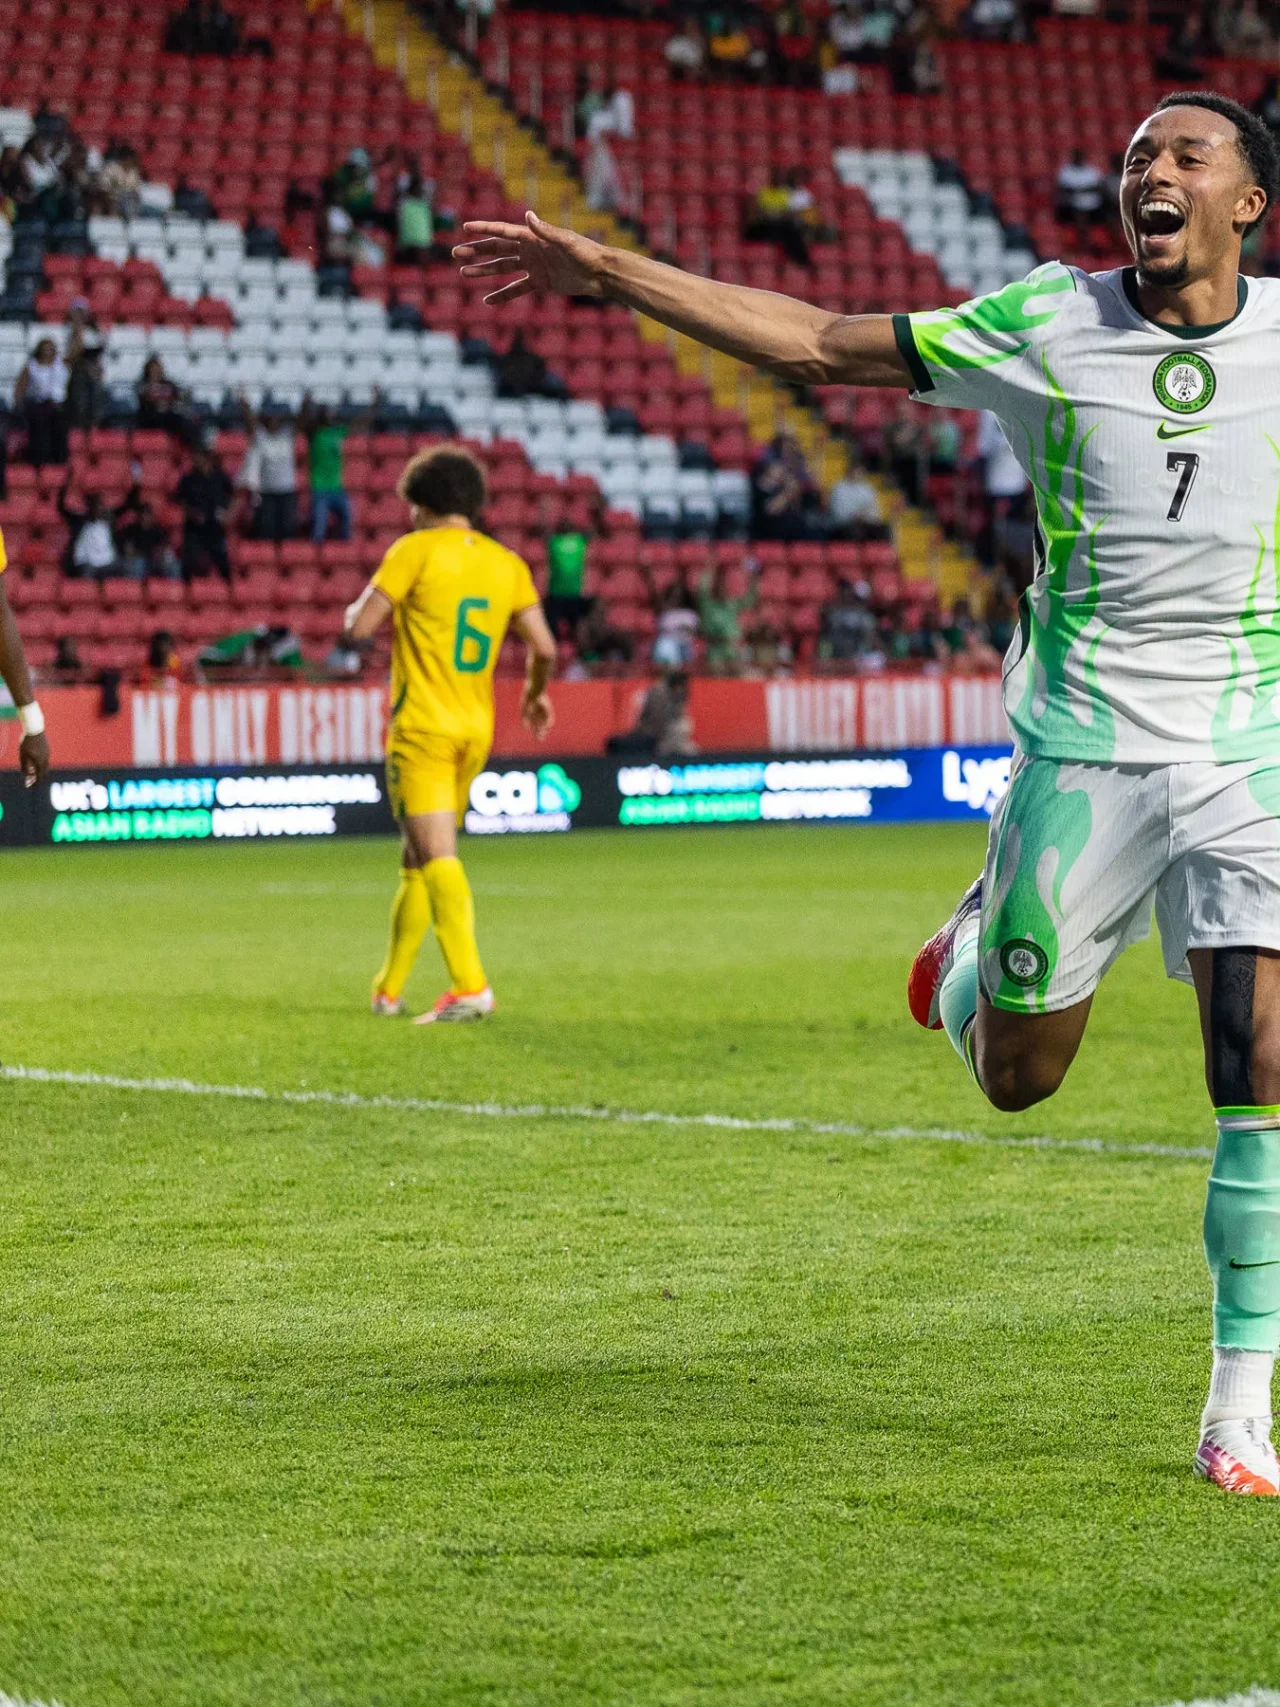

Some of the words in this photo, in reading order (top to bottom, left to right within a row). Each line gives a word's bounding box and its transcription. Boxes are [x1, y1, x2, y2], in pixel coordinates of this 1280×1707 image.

[1160, 355, 1196, 373] FOOTBALL
[1156, 372, 1168, 401] NIGERIA
[1196, 361, 1213, 404] FEDERATION
[1176, 403, 1193, 411] 1945
[1166, 451, 1200, 522] 7
[454, 596, 492, 673] 6
